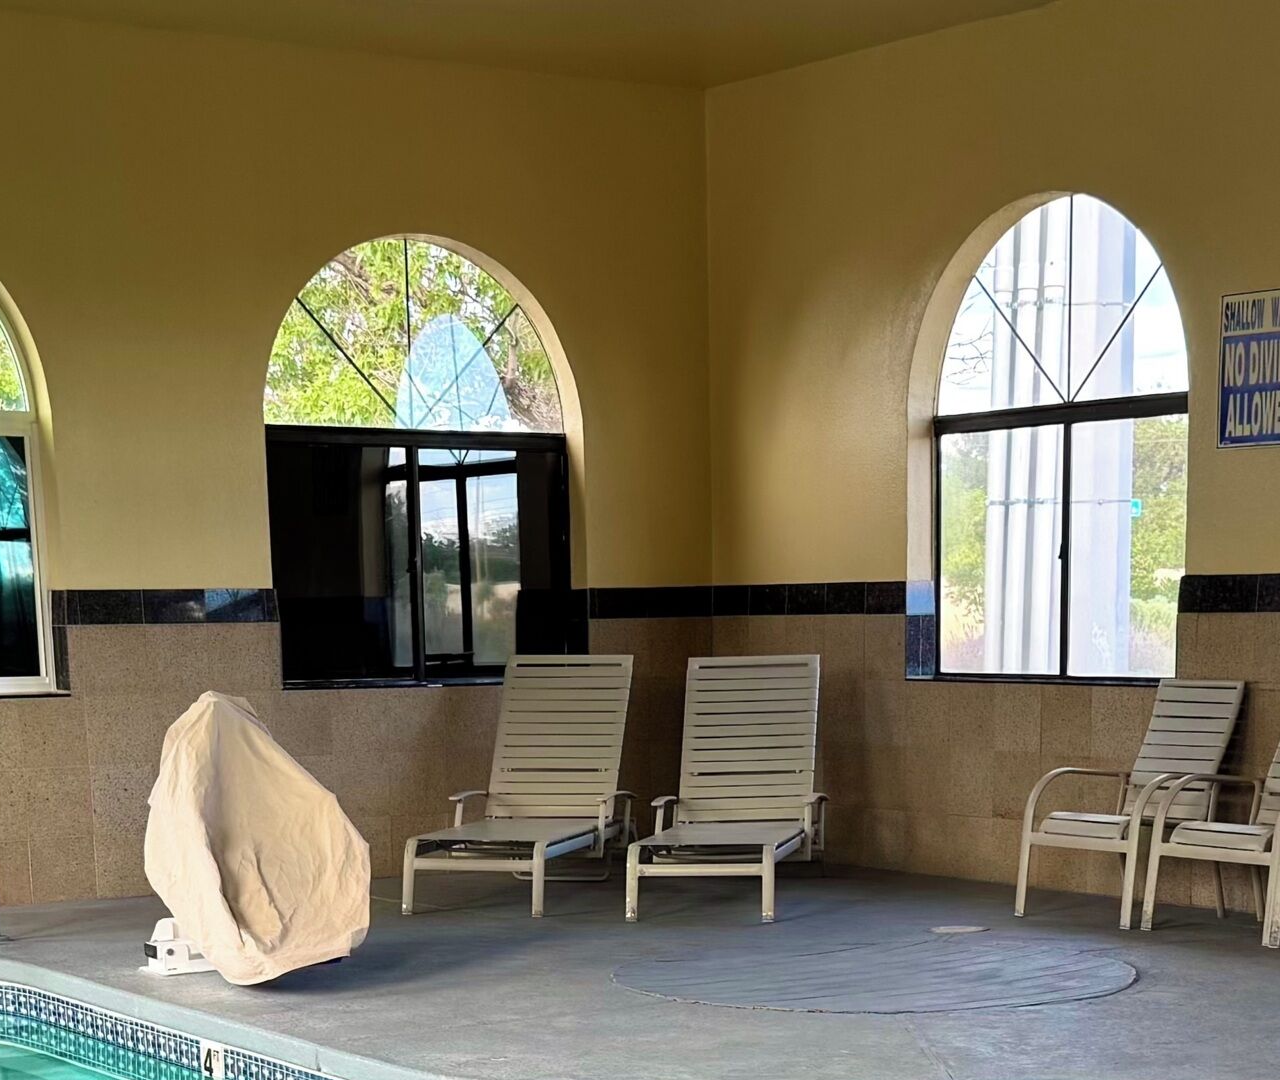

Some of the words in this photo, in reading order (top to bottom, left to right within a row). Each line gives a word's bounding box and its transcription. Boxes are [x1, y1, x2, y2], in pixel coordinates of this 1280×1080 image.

[1224, 298, 1265, 332] SHALLOW
[1224, 342, 1245, 387] NO
[204, 1048, 214, 1077] 4
